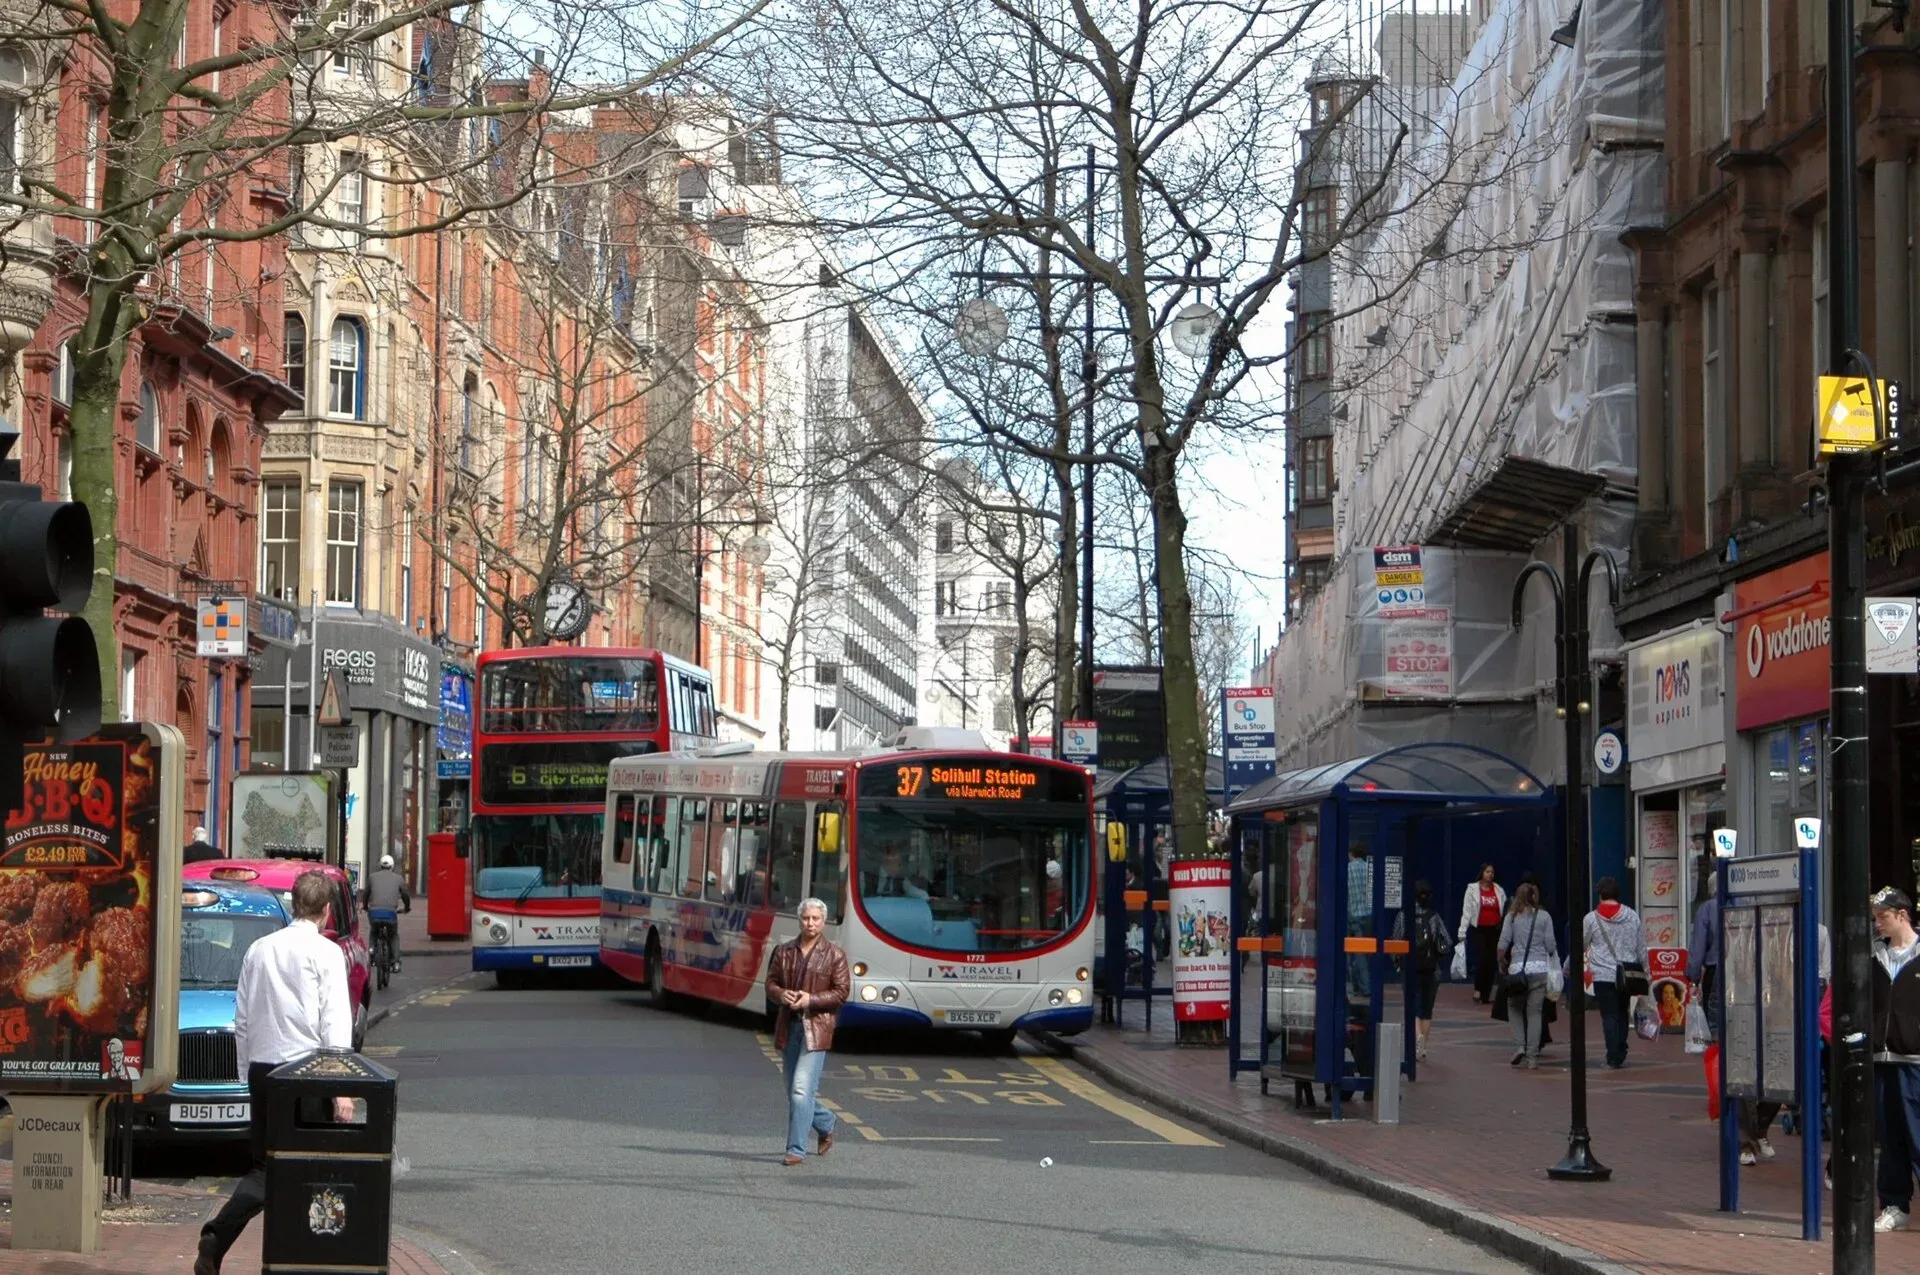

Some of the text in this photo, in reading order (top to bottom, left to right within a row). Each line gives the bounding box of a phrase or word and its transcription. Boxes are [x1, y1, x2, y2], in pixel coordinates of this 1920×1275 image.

[1383, 552, 1411, 562] dsm
[1767, 612, 1831, 660] vodafone
[1397, 657, 1440, 671] STOP
[1655, 659, 1690, 704] news
[1655, 705, 1690, 725] express
[1250, 723, 1266, 731] Stop
[328, 744, 351, 752] Pelican
[24, 752, 97, 796] Honey
[512, 767, 526, 784] 6
[540, 775, 566, 785] City
[805, 769, 830, 783] TRAVEL
[897, 767, 1036, 796] 37 Solihull Station
[946, 785, 1021, 798] via Warwick Road
[6, 824, 108, 846] BONELESS BITES
[25, 847, 65, 863] £2.49
[1191, 867, 1221, 882] your
[1747, 866, 1780, 880] Travel Information
[961, 966, 1012, 974] TRAVEL
[950, 1013, 996, 1023] BX56 XCR
[2, 1060, 100, 1071] YOU'VE GOT GREAT TASTE
[217, 1105, 245, 1119] TCJ
[18, 1118, 81, 1132] JCDecaux
[32, 1153, 63, 1164] COUNCIL
[23, 1166, 73, 1178] INFORMATION
[32, 1179, 64, 1190] ON REAR
